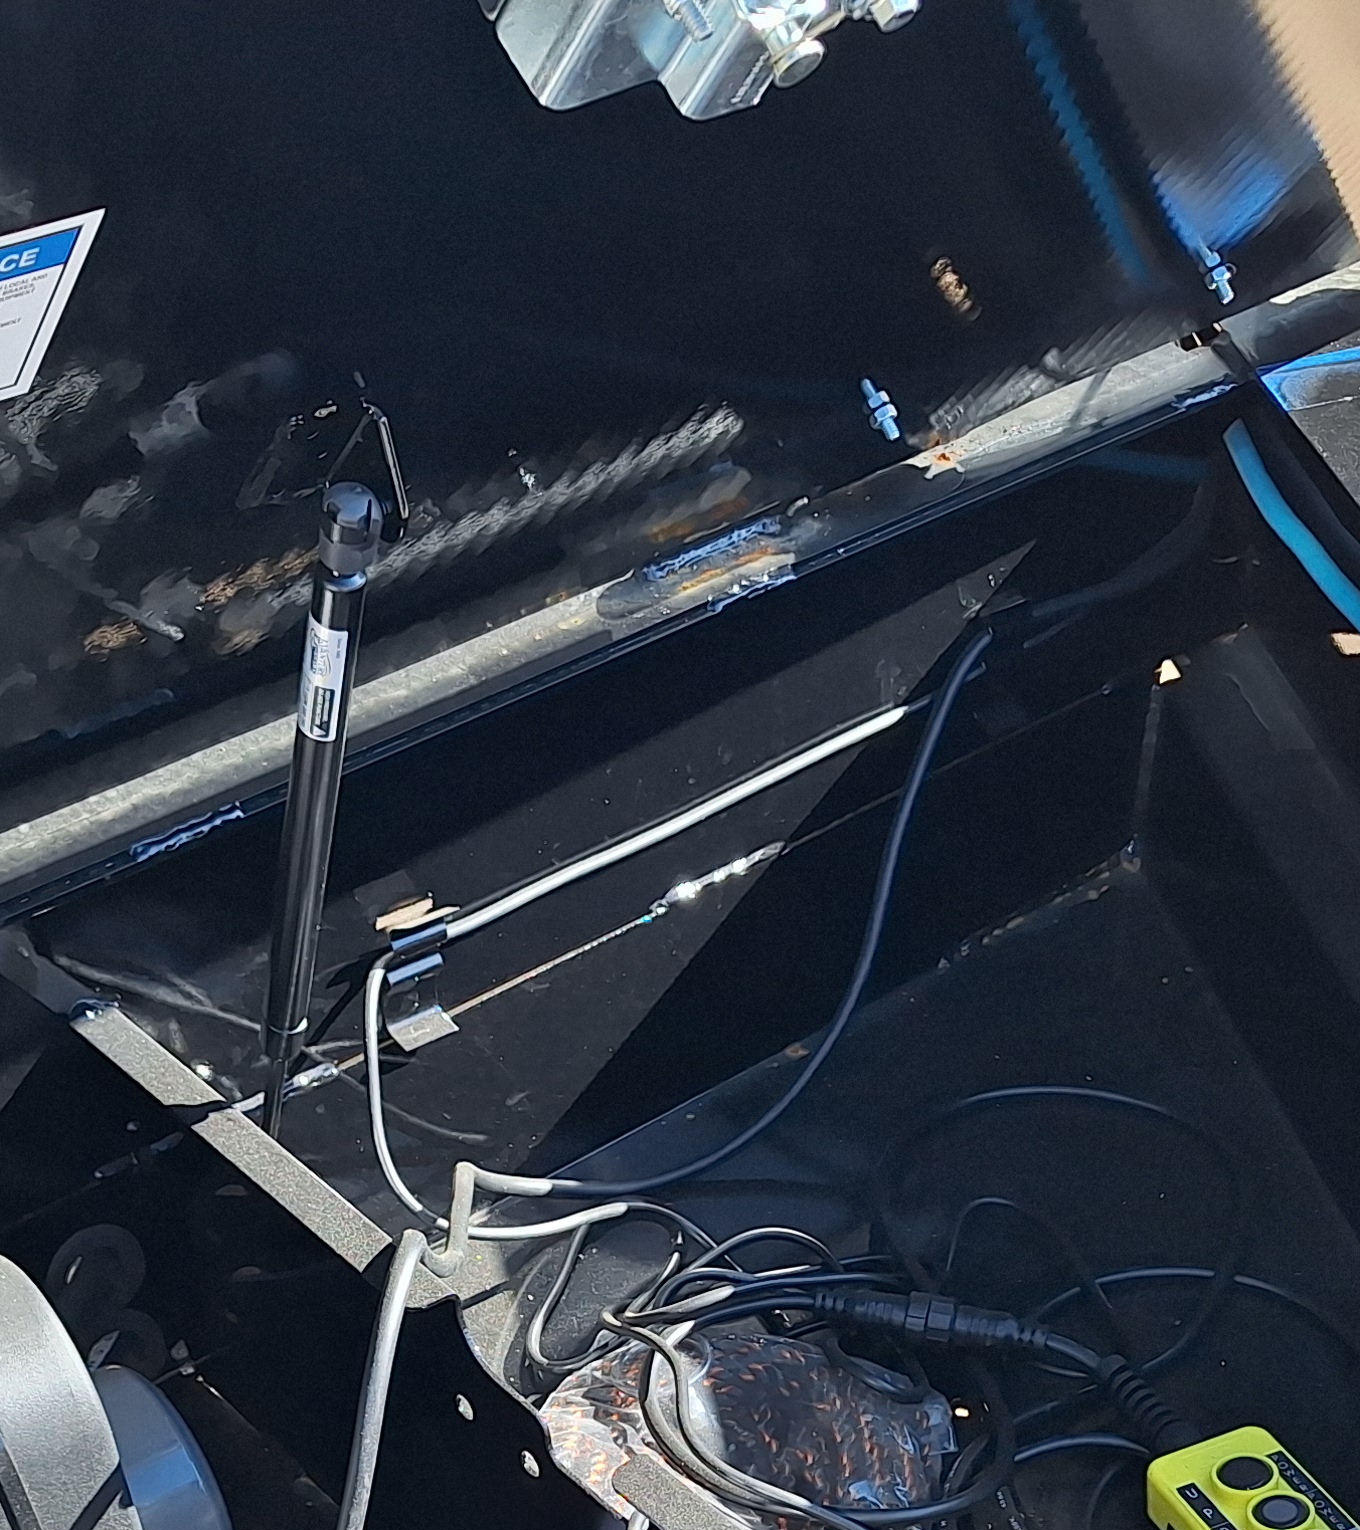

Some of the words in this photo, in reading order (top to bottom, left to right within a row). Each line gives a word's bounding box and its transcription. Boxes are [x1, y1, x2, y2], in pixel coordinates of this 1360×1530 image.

[1185, 1488, 1214, 1519] UP
[1271, 1455, 1308, 1491] POWER
[1307, 1493, 1345, 1530] POWER
